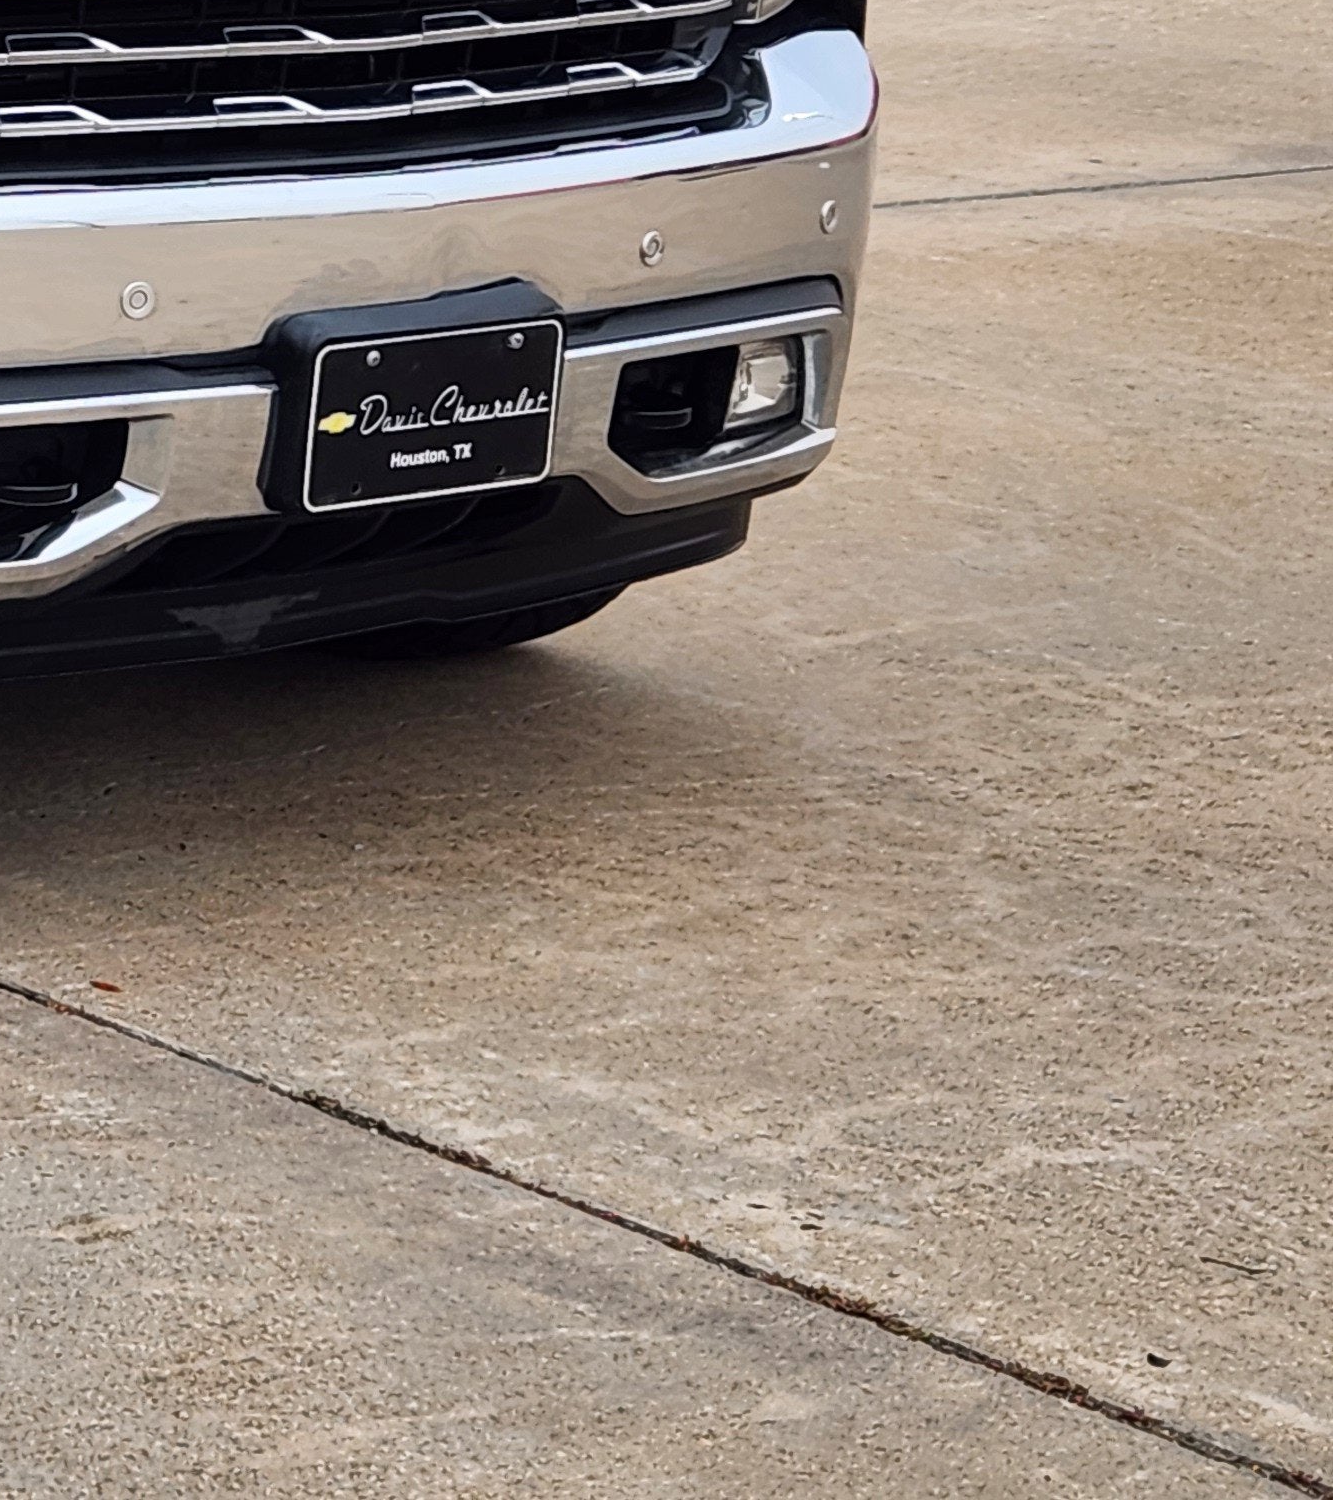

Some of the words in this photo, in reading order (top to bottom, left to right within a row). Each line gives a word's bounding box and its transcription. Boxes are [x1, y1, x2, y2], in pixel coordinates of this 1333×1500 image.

[359, 393, 429, 436] Davis
[430, 385, 549, 426] Chevrolet
[389, 448, 450, 469] Houston,
[453, 442, 473, 460] TX
